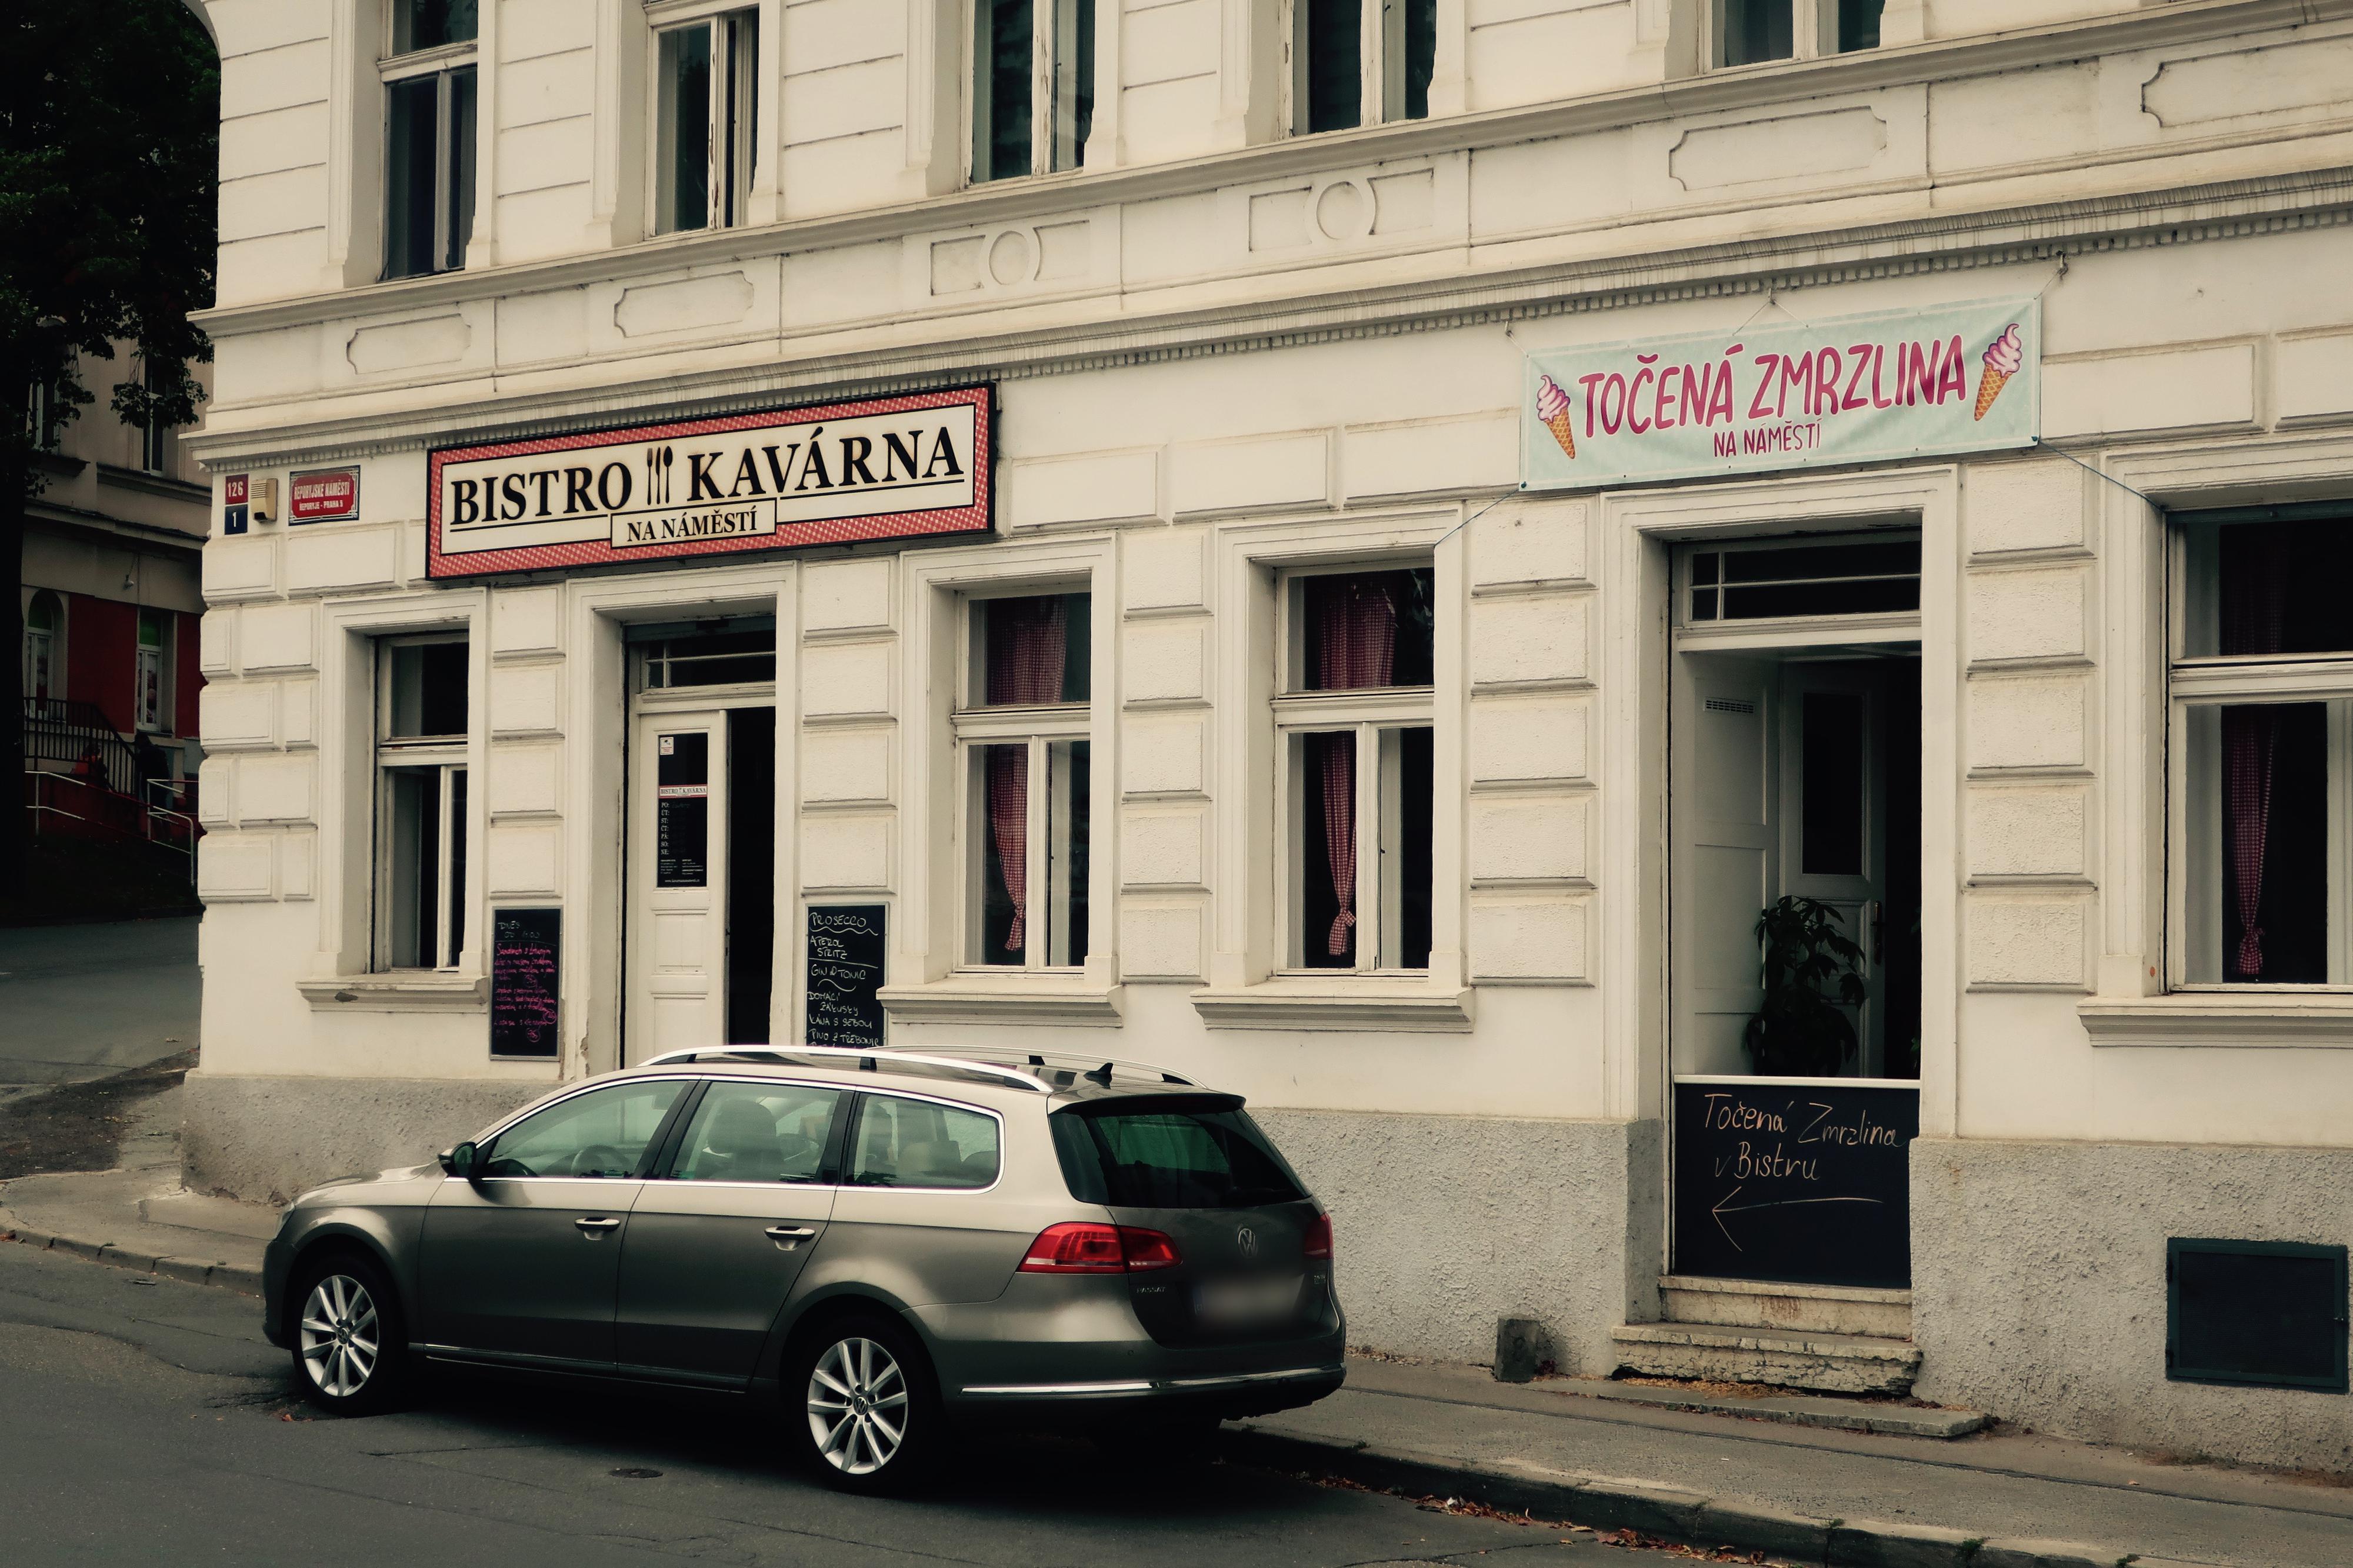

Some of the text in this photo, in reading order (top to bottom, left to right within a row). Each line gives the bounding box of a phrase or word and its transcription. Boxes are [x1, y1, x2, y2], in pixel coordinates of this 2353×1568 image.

[1578, 334, 1967, 439] TOČENÁ ZMRZLINA
[1713, 418, 1823, 458] NA NÁMĚSTÍ
[450, 425, 965, 526] BISTRO KAVÁRNA
[228, 481, 244, 498] 126
[325, 479, 351, 496] NÁMĚSTÍ
[323, 500, 339, 509] PRAHA
[232, 511, 237, 528] 1
[626, 506, 758, 543] NA NÁMĚSTÍ
[809, 912, 866, 928] PROSECCO
[810, 935, 845, 948] APEROL
[811, 963, 828, 976] GIN
[838, 969, 866, 979] TONIC
[807, 991, 840, 1002] DOMÁCÍ
[819, 1002, 858, 1016] ZÁKUSKY
[833, 1017, 839, 1026] S
[842, 1018, 872, 1029] SEBOU
[808, 1028, 829, 1040] PIVO
[1704, 1093, 1906, 1147] Točená Zmrzlina
[1734, 1140, 1820, 1181] Bistru
[1136, 1286, 1166, 1294] PASSAT
